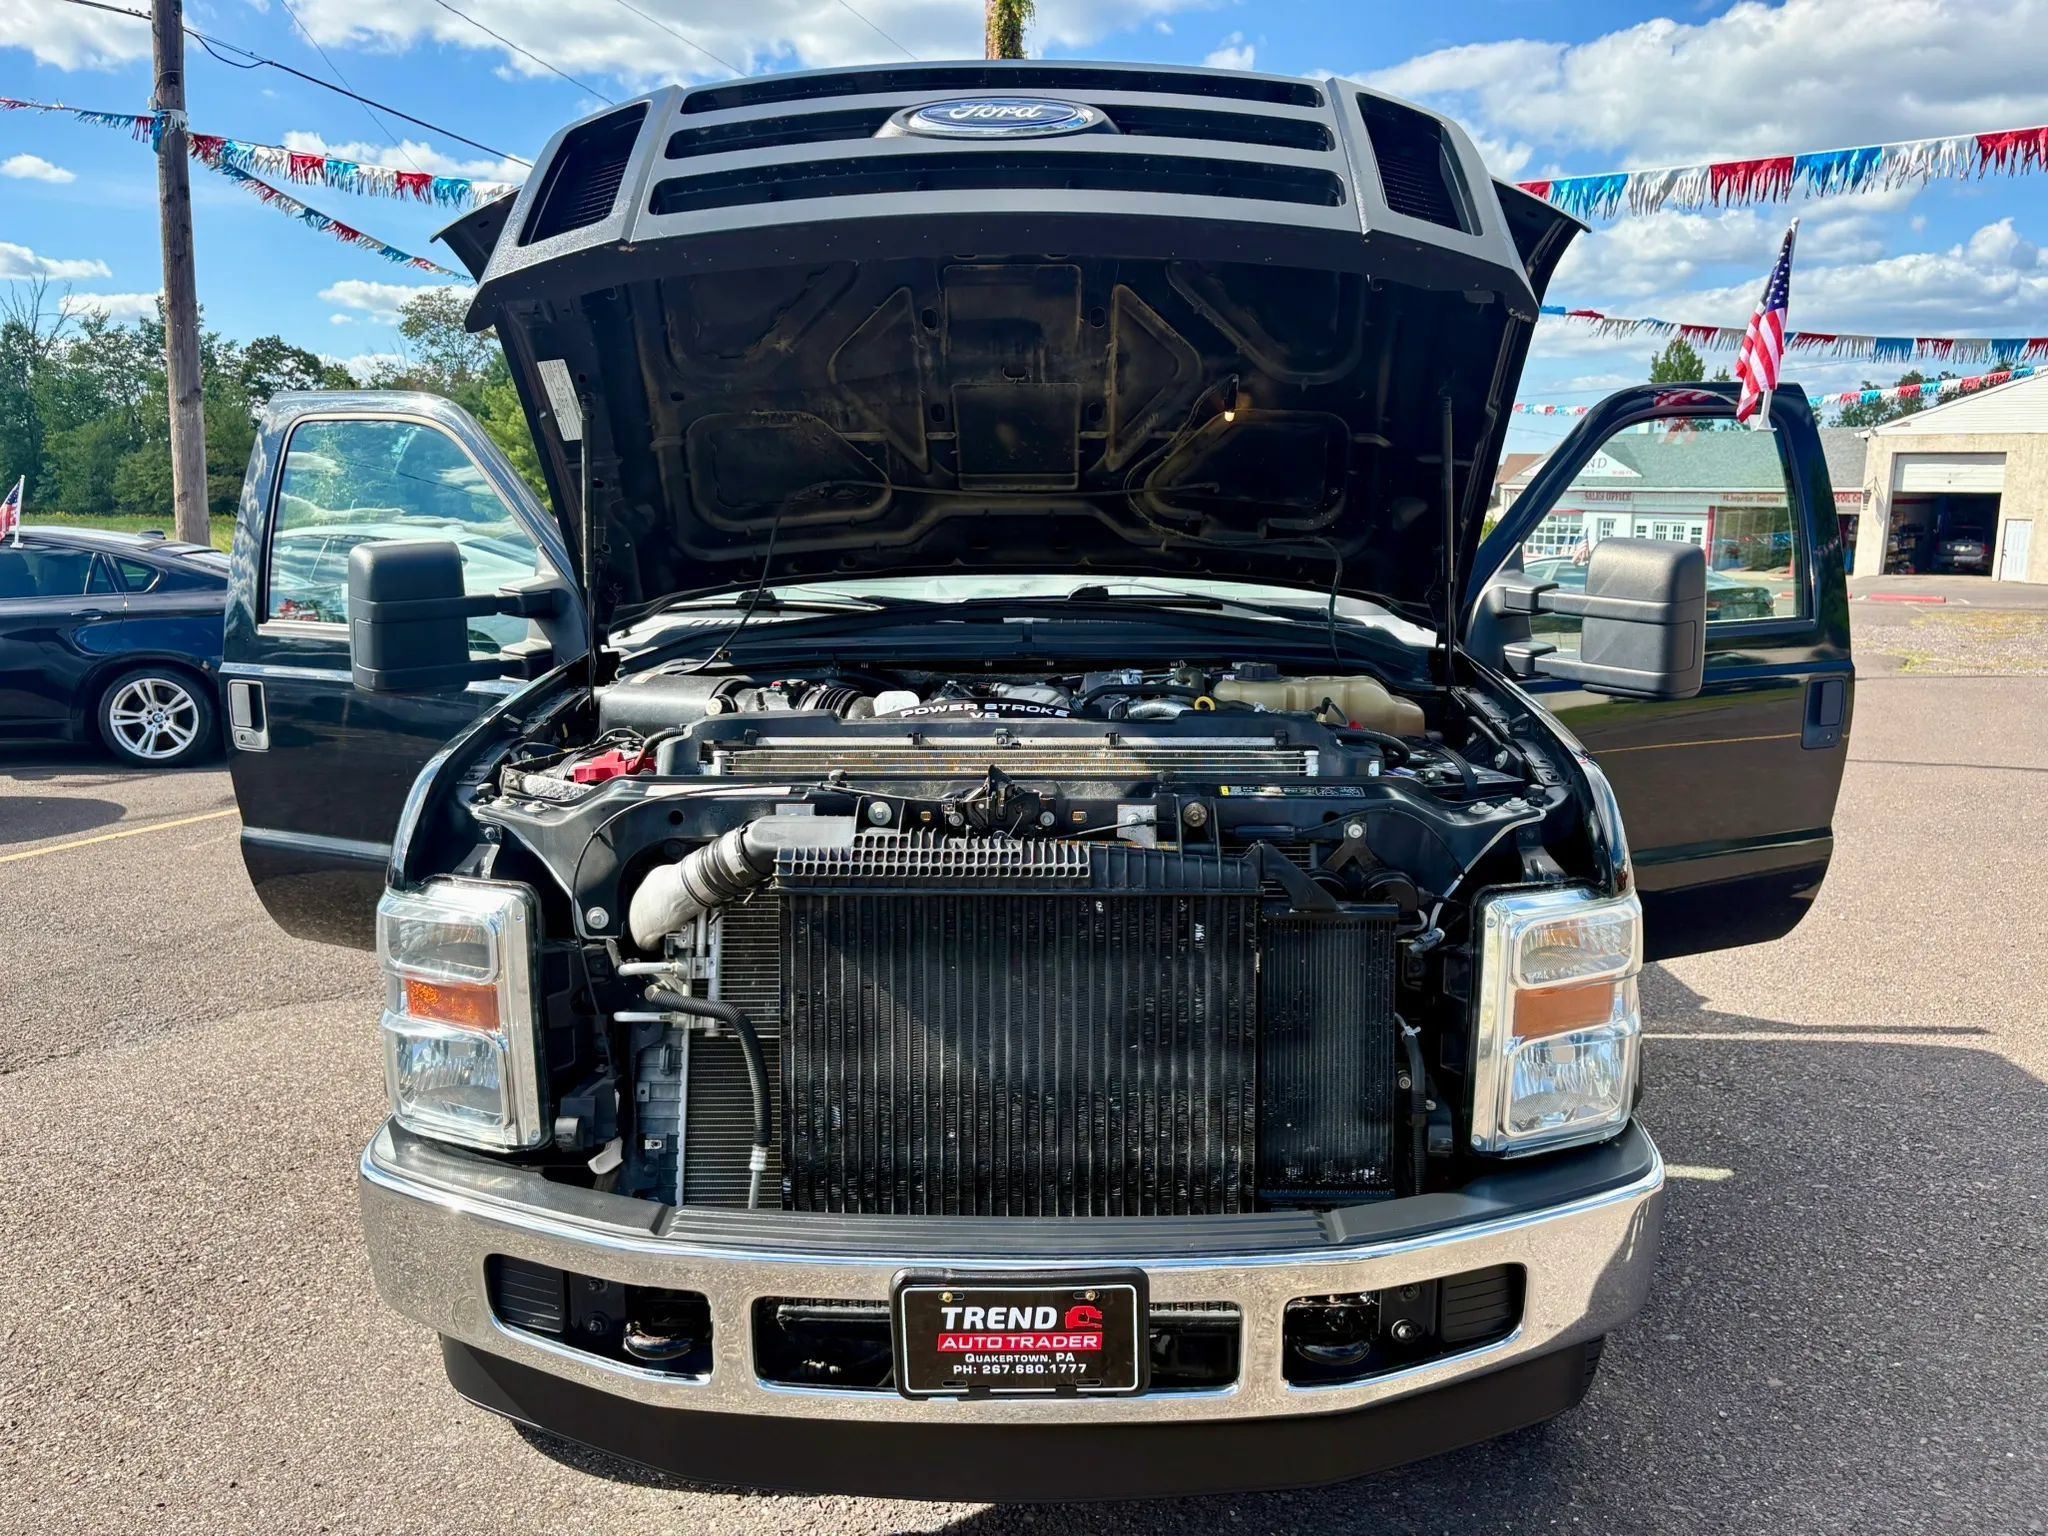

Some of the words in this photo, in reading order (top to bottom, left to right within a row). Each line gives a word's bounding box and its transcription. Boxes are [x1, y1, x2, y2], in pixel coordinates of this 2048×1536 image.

[949, 102, 1043, 120] Ford
[900, 703, 979, 718] POWER
[984, 703, 1071, 718] STROKE
[941, 1306, 1058, 1330] TREND
[941, 1336, 1003, 1349] AUTO
[1007, 1335, 1098, 1349] TRADER
[1056, 1352, 1076, 1363] PA
[953, 1364, 977, 1375] PH:
[982, 1363, 1087, 1375] 267.680.1777
